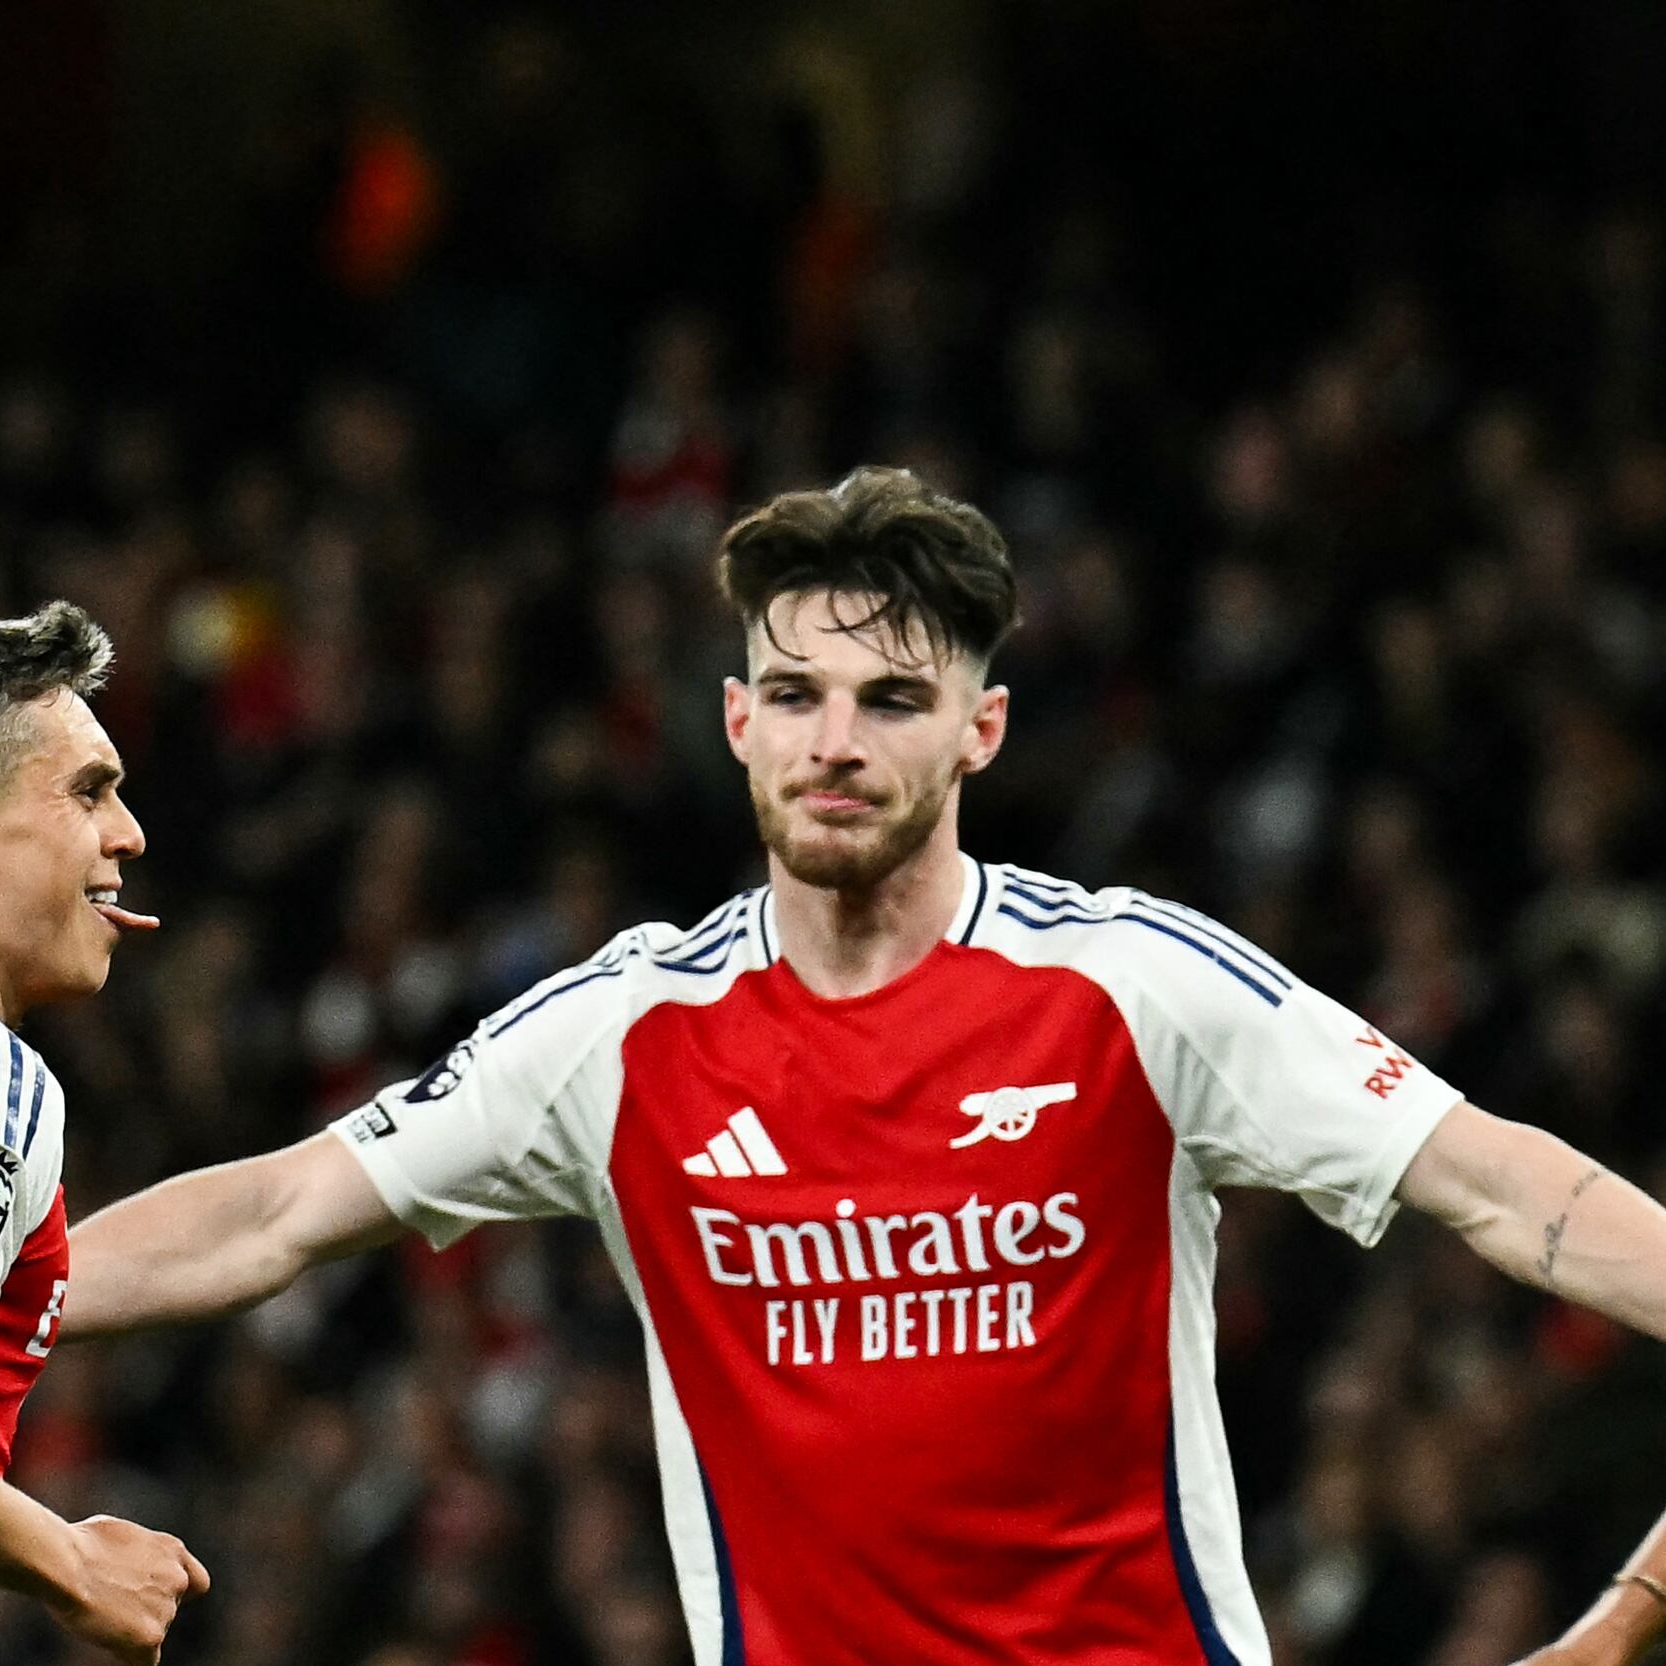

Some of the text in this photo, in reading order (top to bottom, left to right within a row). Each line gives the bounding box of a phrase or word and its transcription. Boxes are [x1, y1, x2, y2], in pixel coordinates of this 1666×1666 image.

[689, 1192, 1086, 1288] Emirates
[766, 1281, 1037, 1367] FLY BETTER
